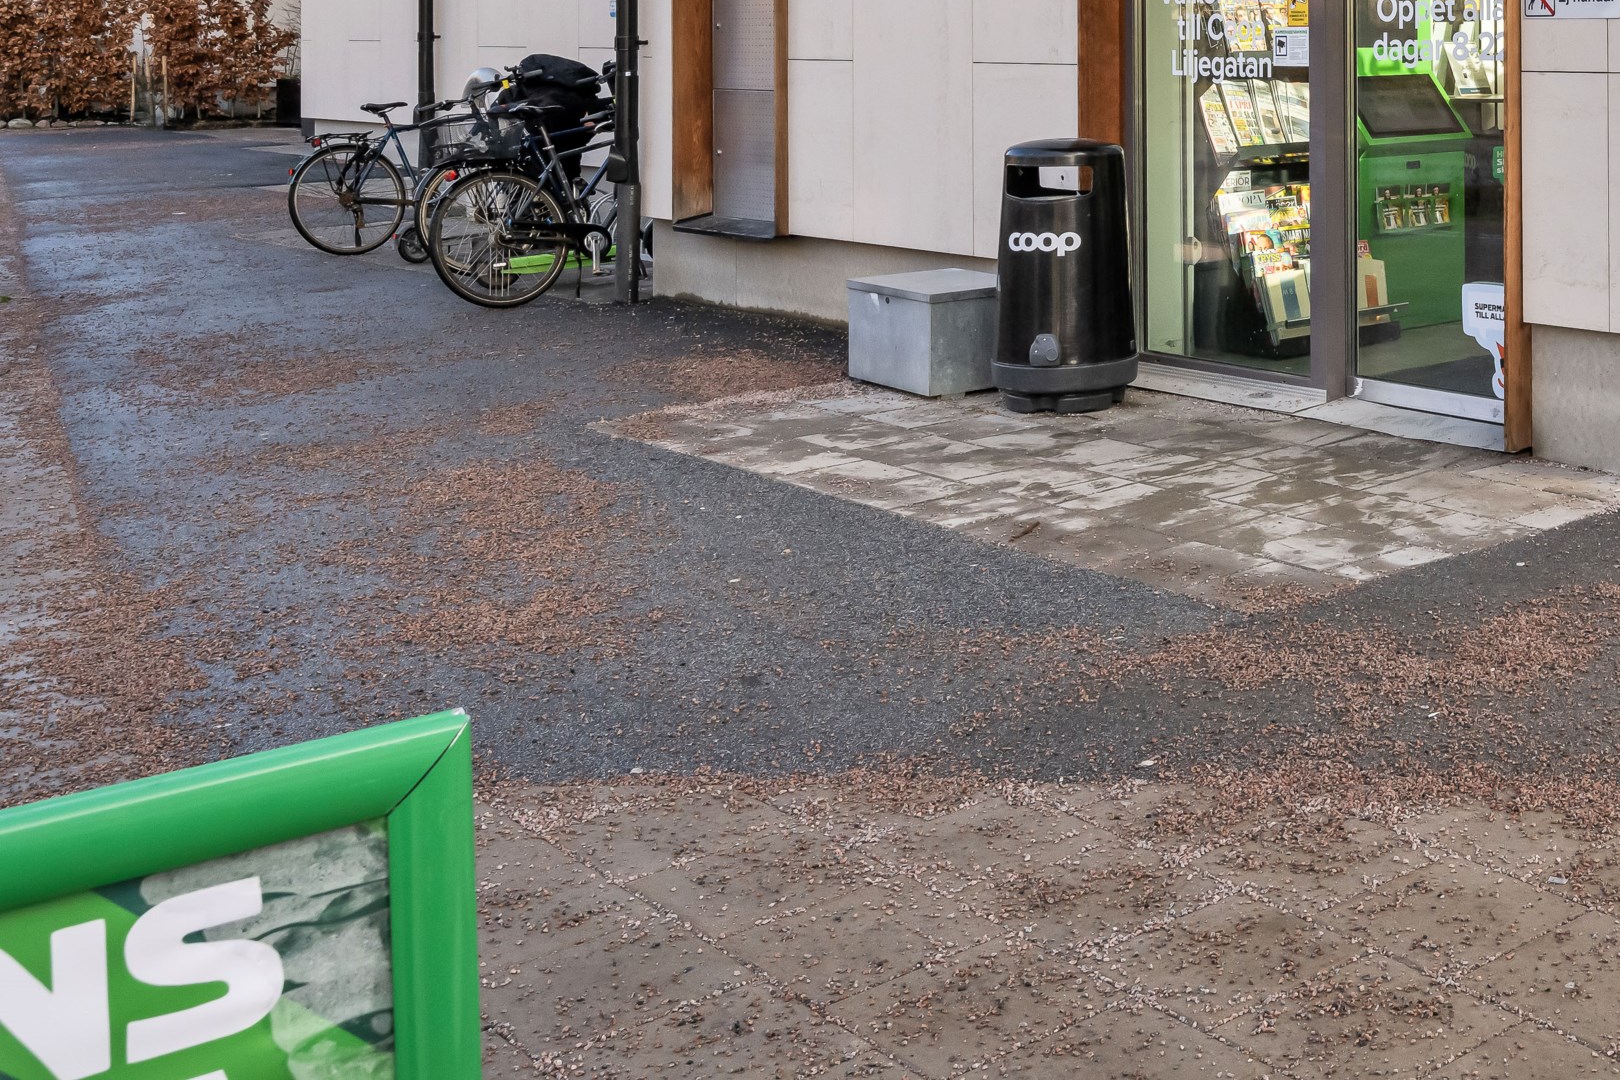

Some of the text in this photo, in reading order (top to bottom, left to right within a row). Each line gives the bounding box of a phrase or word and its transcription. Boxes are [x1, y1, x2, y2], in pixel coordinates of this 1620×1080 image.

[1177, 13, 1266, 47] till Coop
[1171, 49, 1272, 84] Liljegatan
[1373, 31, 1443, 69] dagar
[1009, 232, 1082, 256] coop
[1475, 311, 1489, 319] TILL
